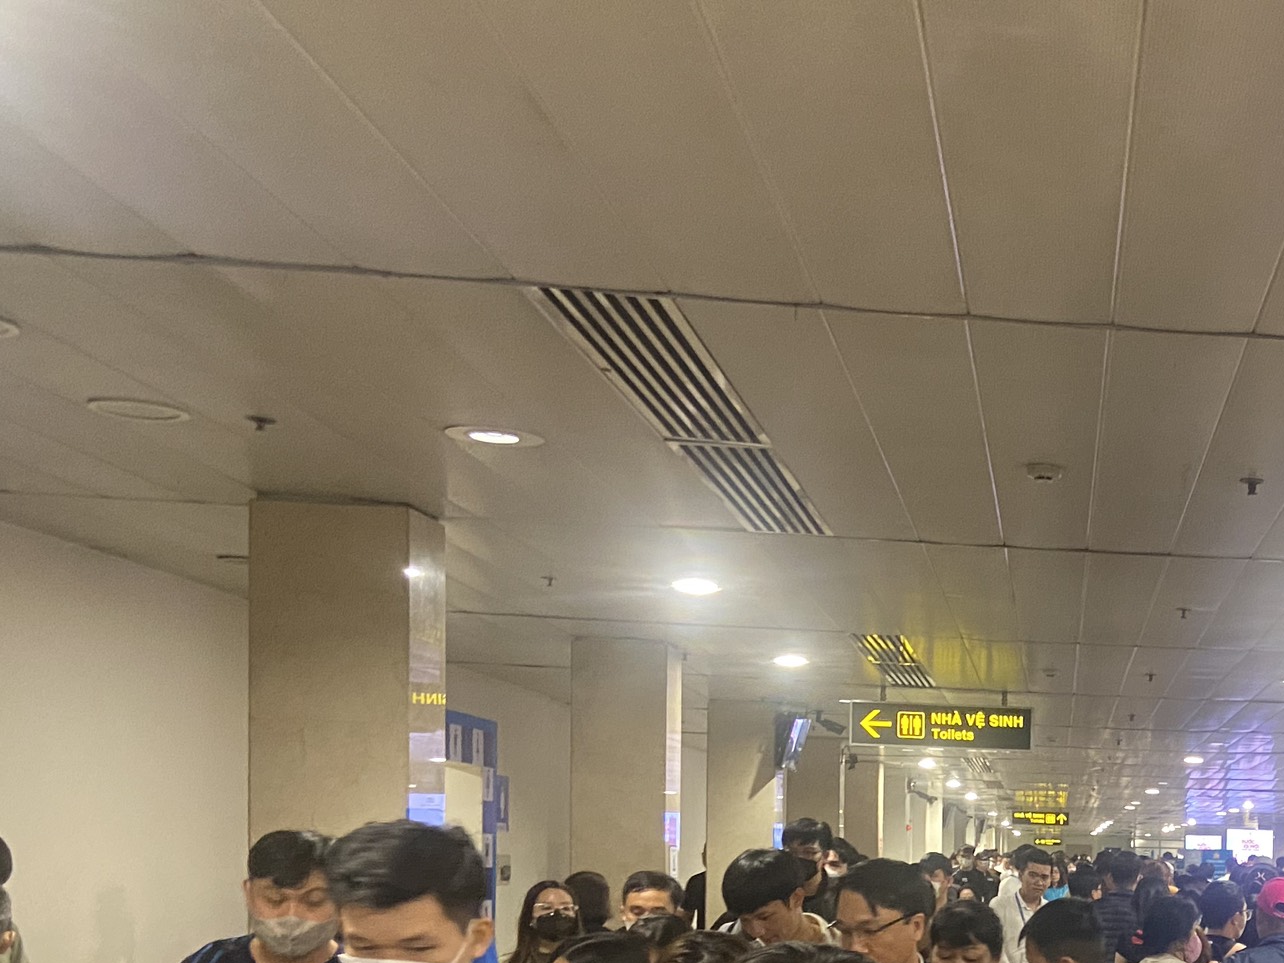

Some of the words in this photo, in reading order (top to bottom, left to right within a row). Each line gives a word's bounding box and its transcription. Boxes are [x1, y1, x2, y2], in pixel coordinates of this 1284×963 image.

[931, 710, 962, 726] NHÀ
[965, 711, 986, 729] VỆ
[988, 714, 1024, 728] SINH
[931, 728, 975, 741] Toilets
